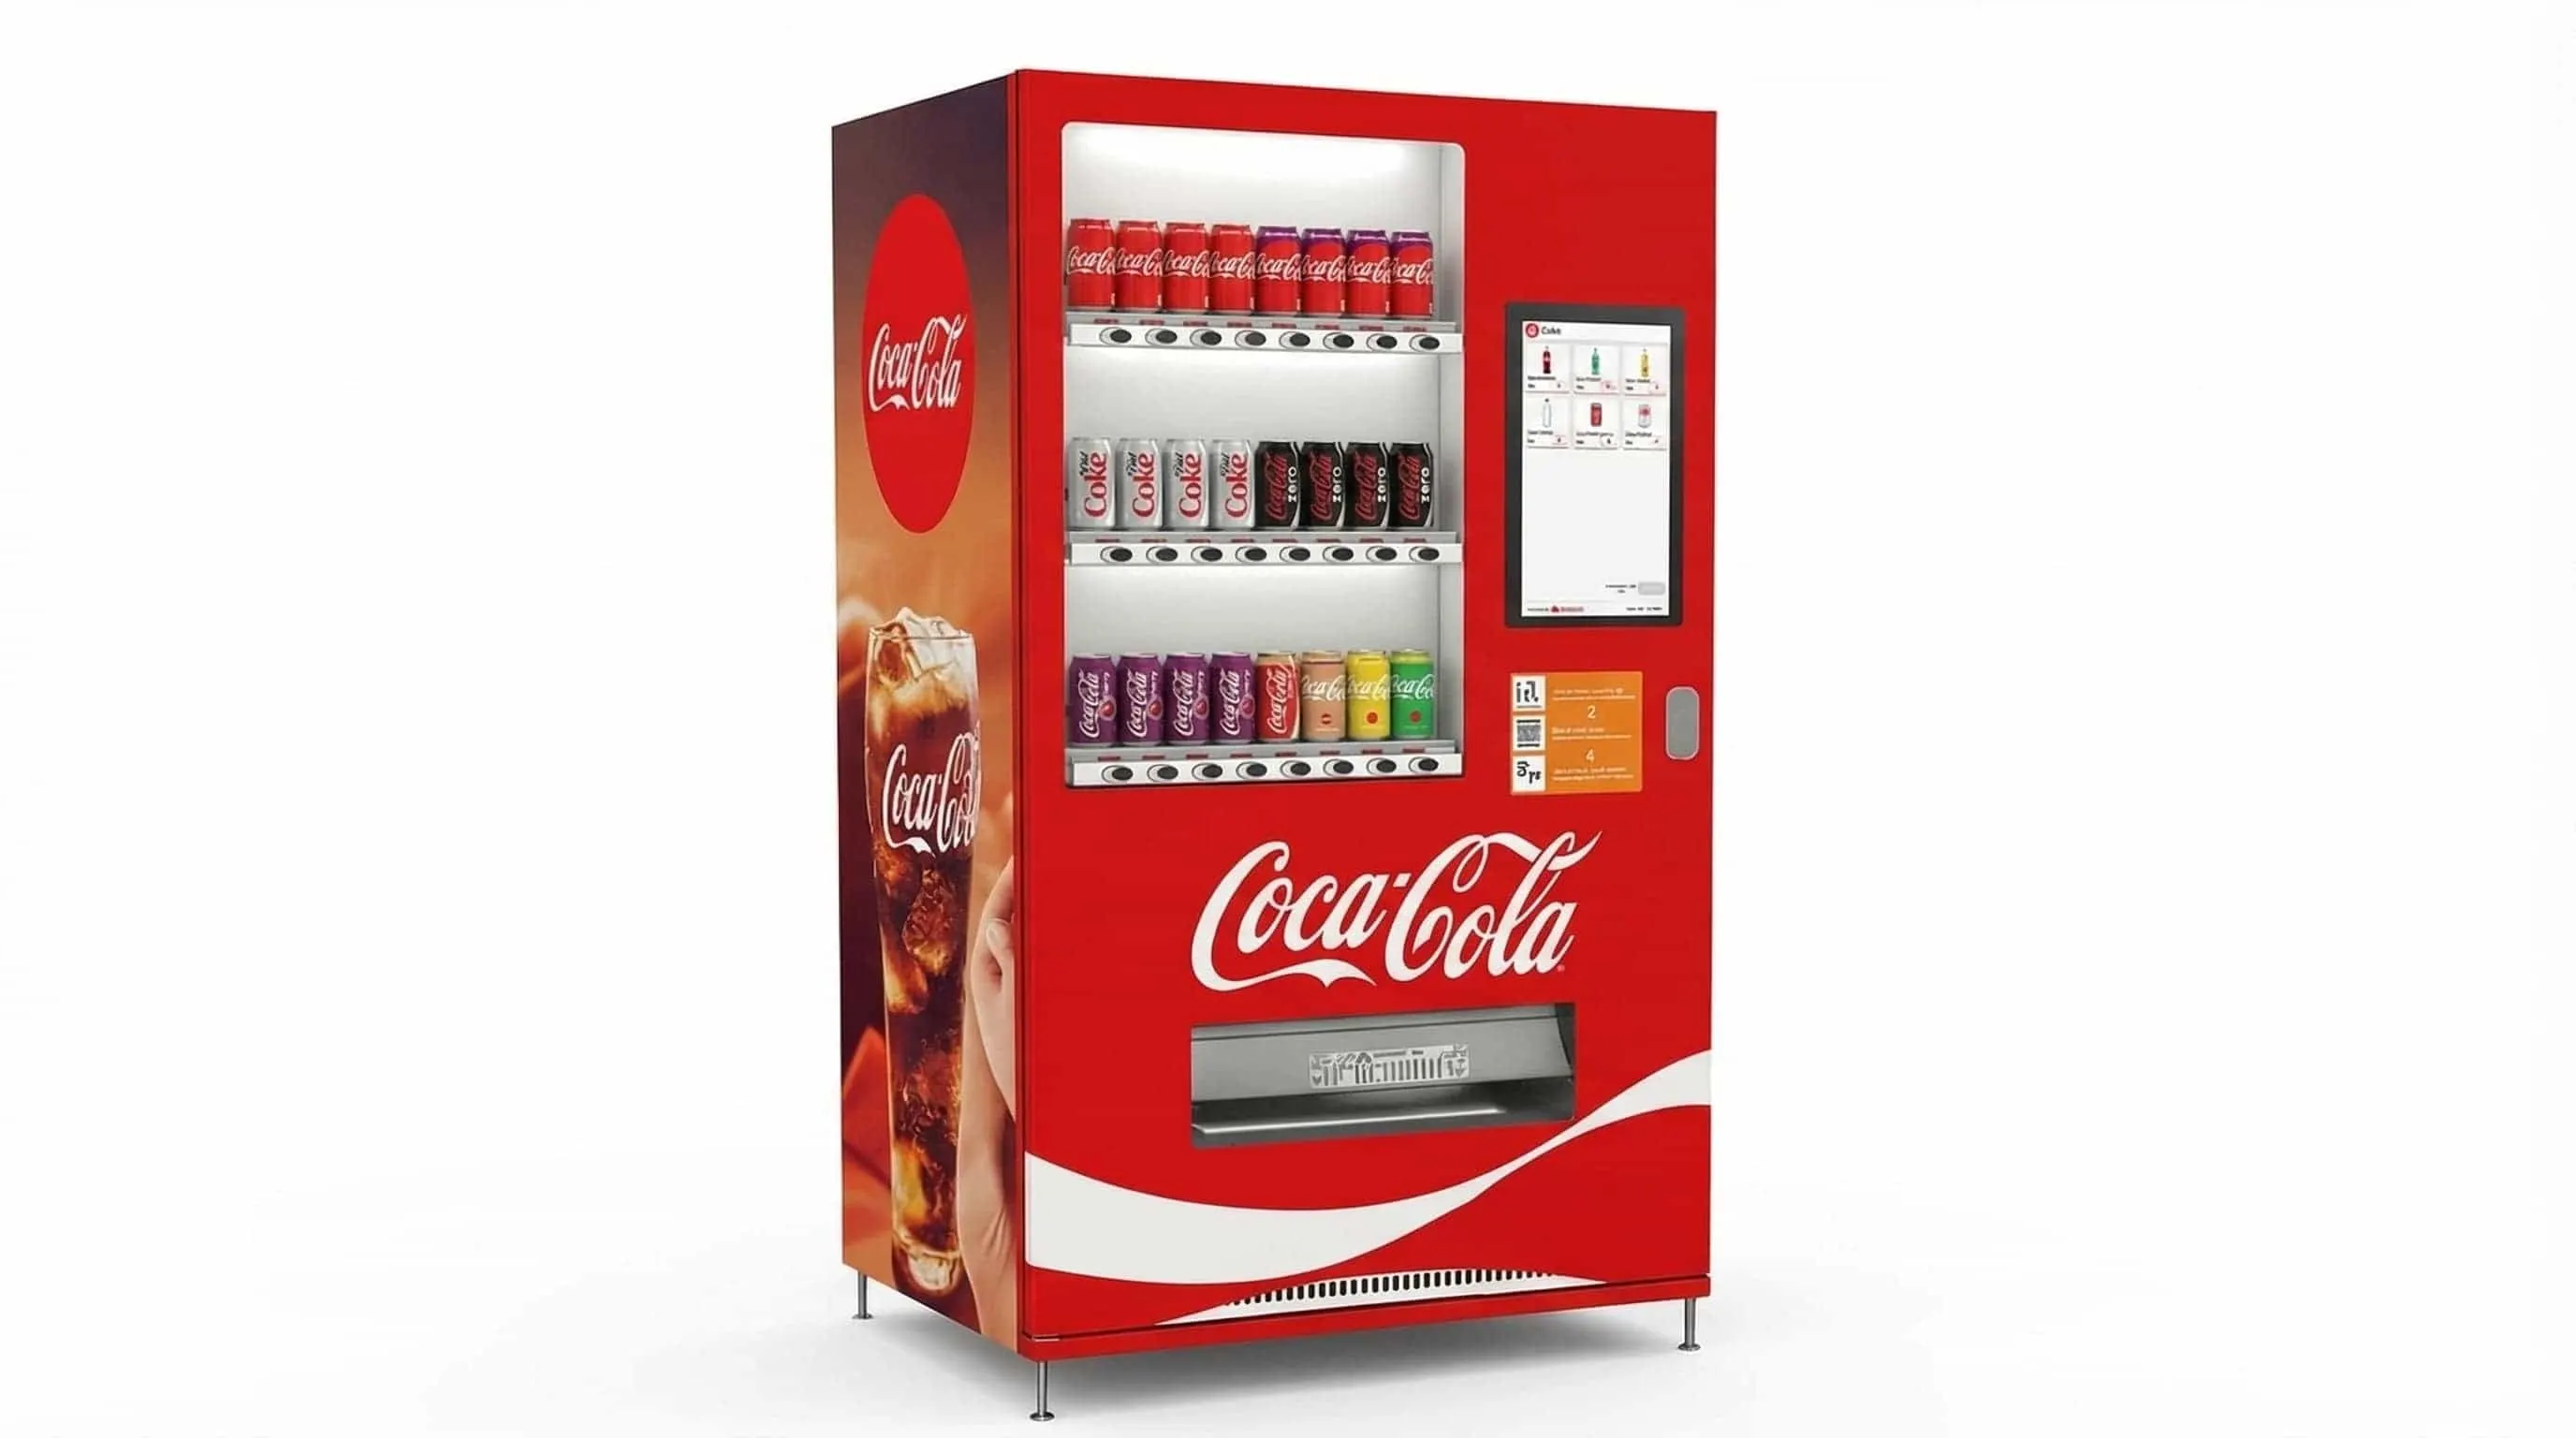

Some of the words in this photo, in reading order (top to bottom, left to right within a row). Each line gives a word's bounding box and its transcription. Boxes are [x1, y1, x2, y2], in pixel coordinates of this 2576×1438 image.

[869, 314, 967, 412] Coca-Cola
[1083, 451, 1107, 518] Coke
[1132, 451, 1155, 518] Coke
[1178, 452, 1202, 518] Coke
[1224, 453, 1248, 518] Coke
[1078, 668, 1100, 738] Coca-Cola
[1126, 668, 1148, 738] Coca-Cola
[1172, 667, 1194, 736] Coca-Cola
[1219, 667, 1240, 735] Coca-Cola
[1587, 705, 1596, 719] 2
[1586, 748, 1595, 763] 4
[1191, 830, 1603, 992] Coca-Cola
